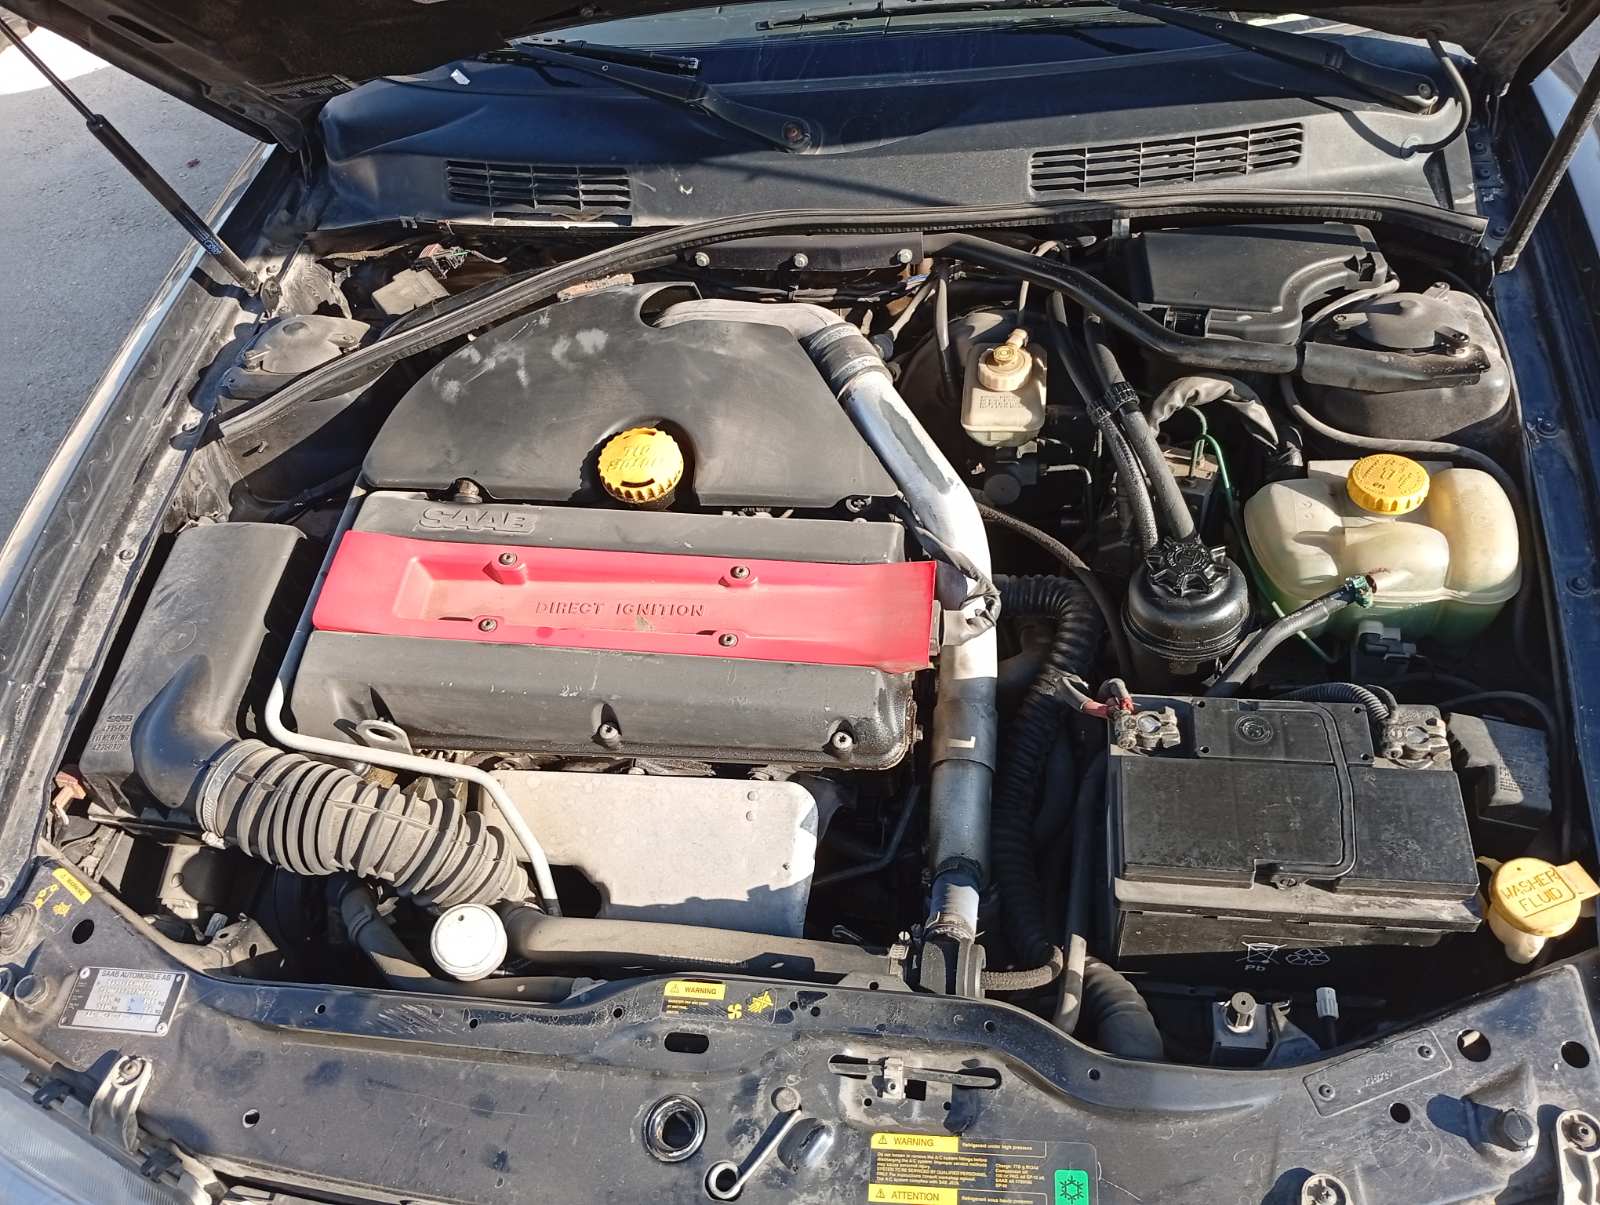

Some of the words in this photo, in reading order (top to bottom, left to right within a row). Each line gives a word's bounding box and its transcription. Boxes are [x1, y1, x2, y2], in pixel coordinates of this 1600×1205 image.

[419, 507, 538, 534] SAAB
[536, 602, 604, 615] DIRECT
[616, 602, 704, 616] IGNITION
[1501, 870, 1559, 899] WASHER
[1518, 887, 1563, 911] FLUID
[101, 970, 119, 978] SAAB
[120, 971, 160, 980] AUTOMOBILE
[684, 987, 717, 995] WARNING
[894, 1137, 934, 1147] WARNING
[891, 1190, 940, 1201] ATTENTION
